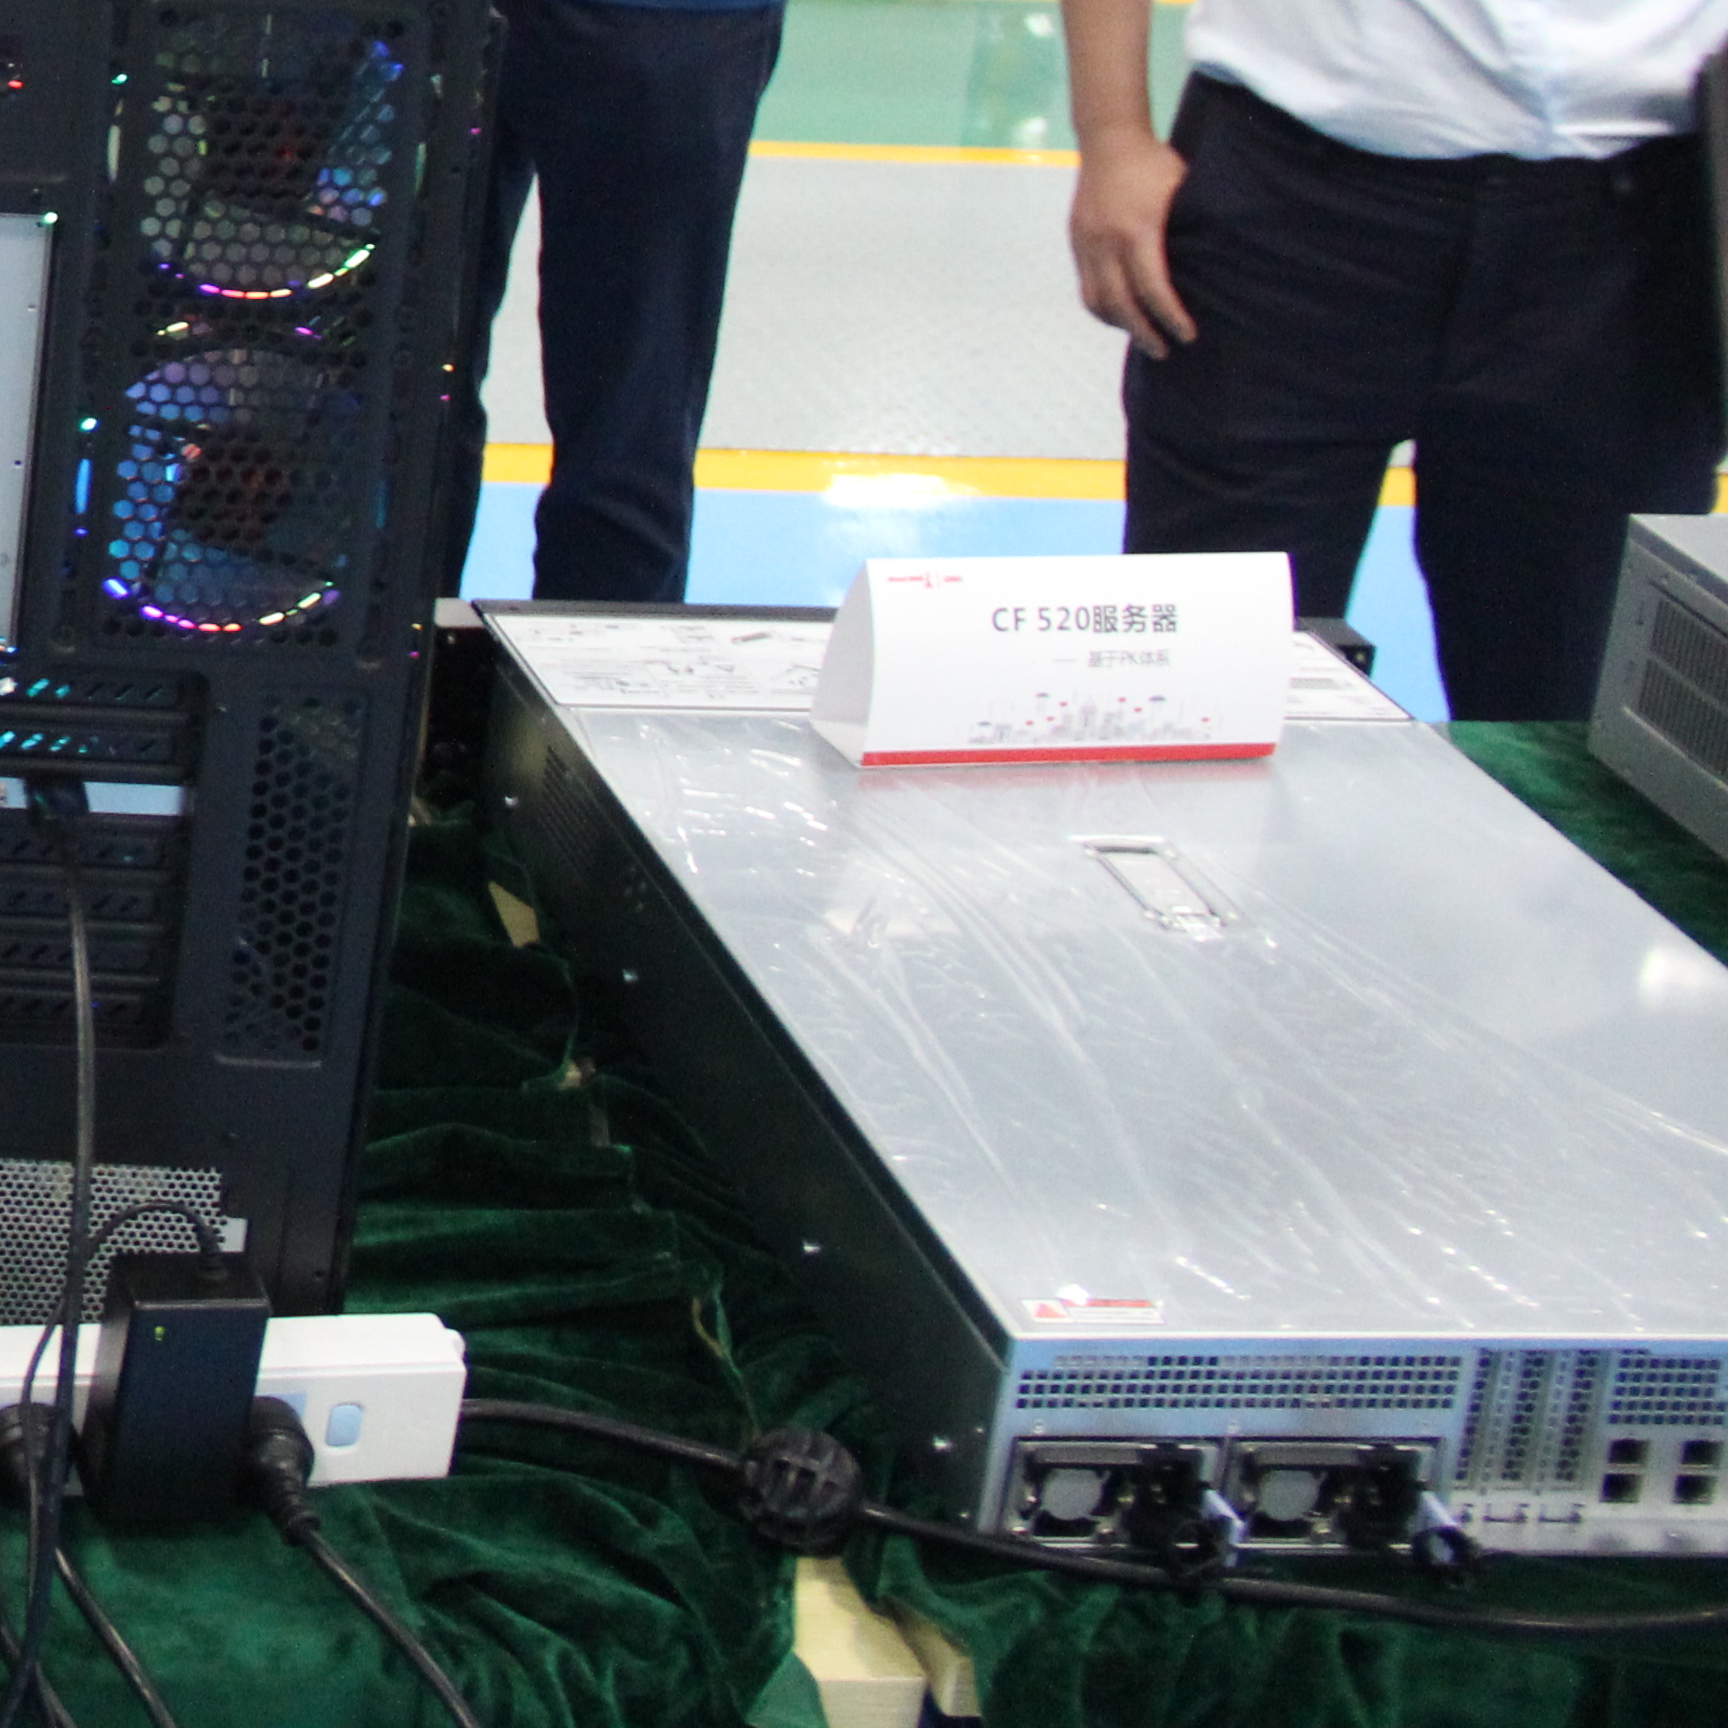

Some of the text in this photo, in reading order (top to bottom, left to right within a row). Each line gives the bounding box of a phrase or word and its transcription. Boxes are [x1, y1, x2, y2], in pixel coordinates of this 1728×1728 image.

[992, 604, 1178, 634] CF 520服务器
